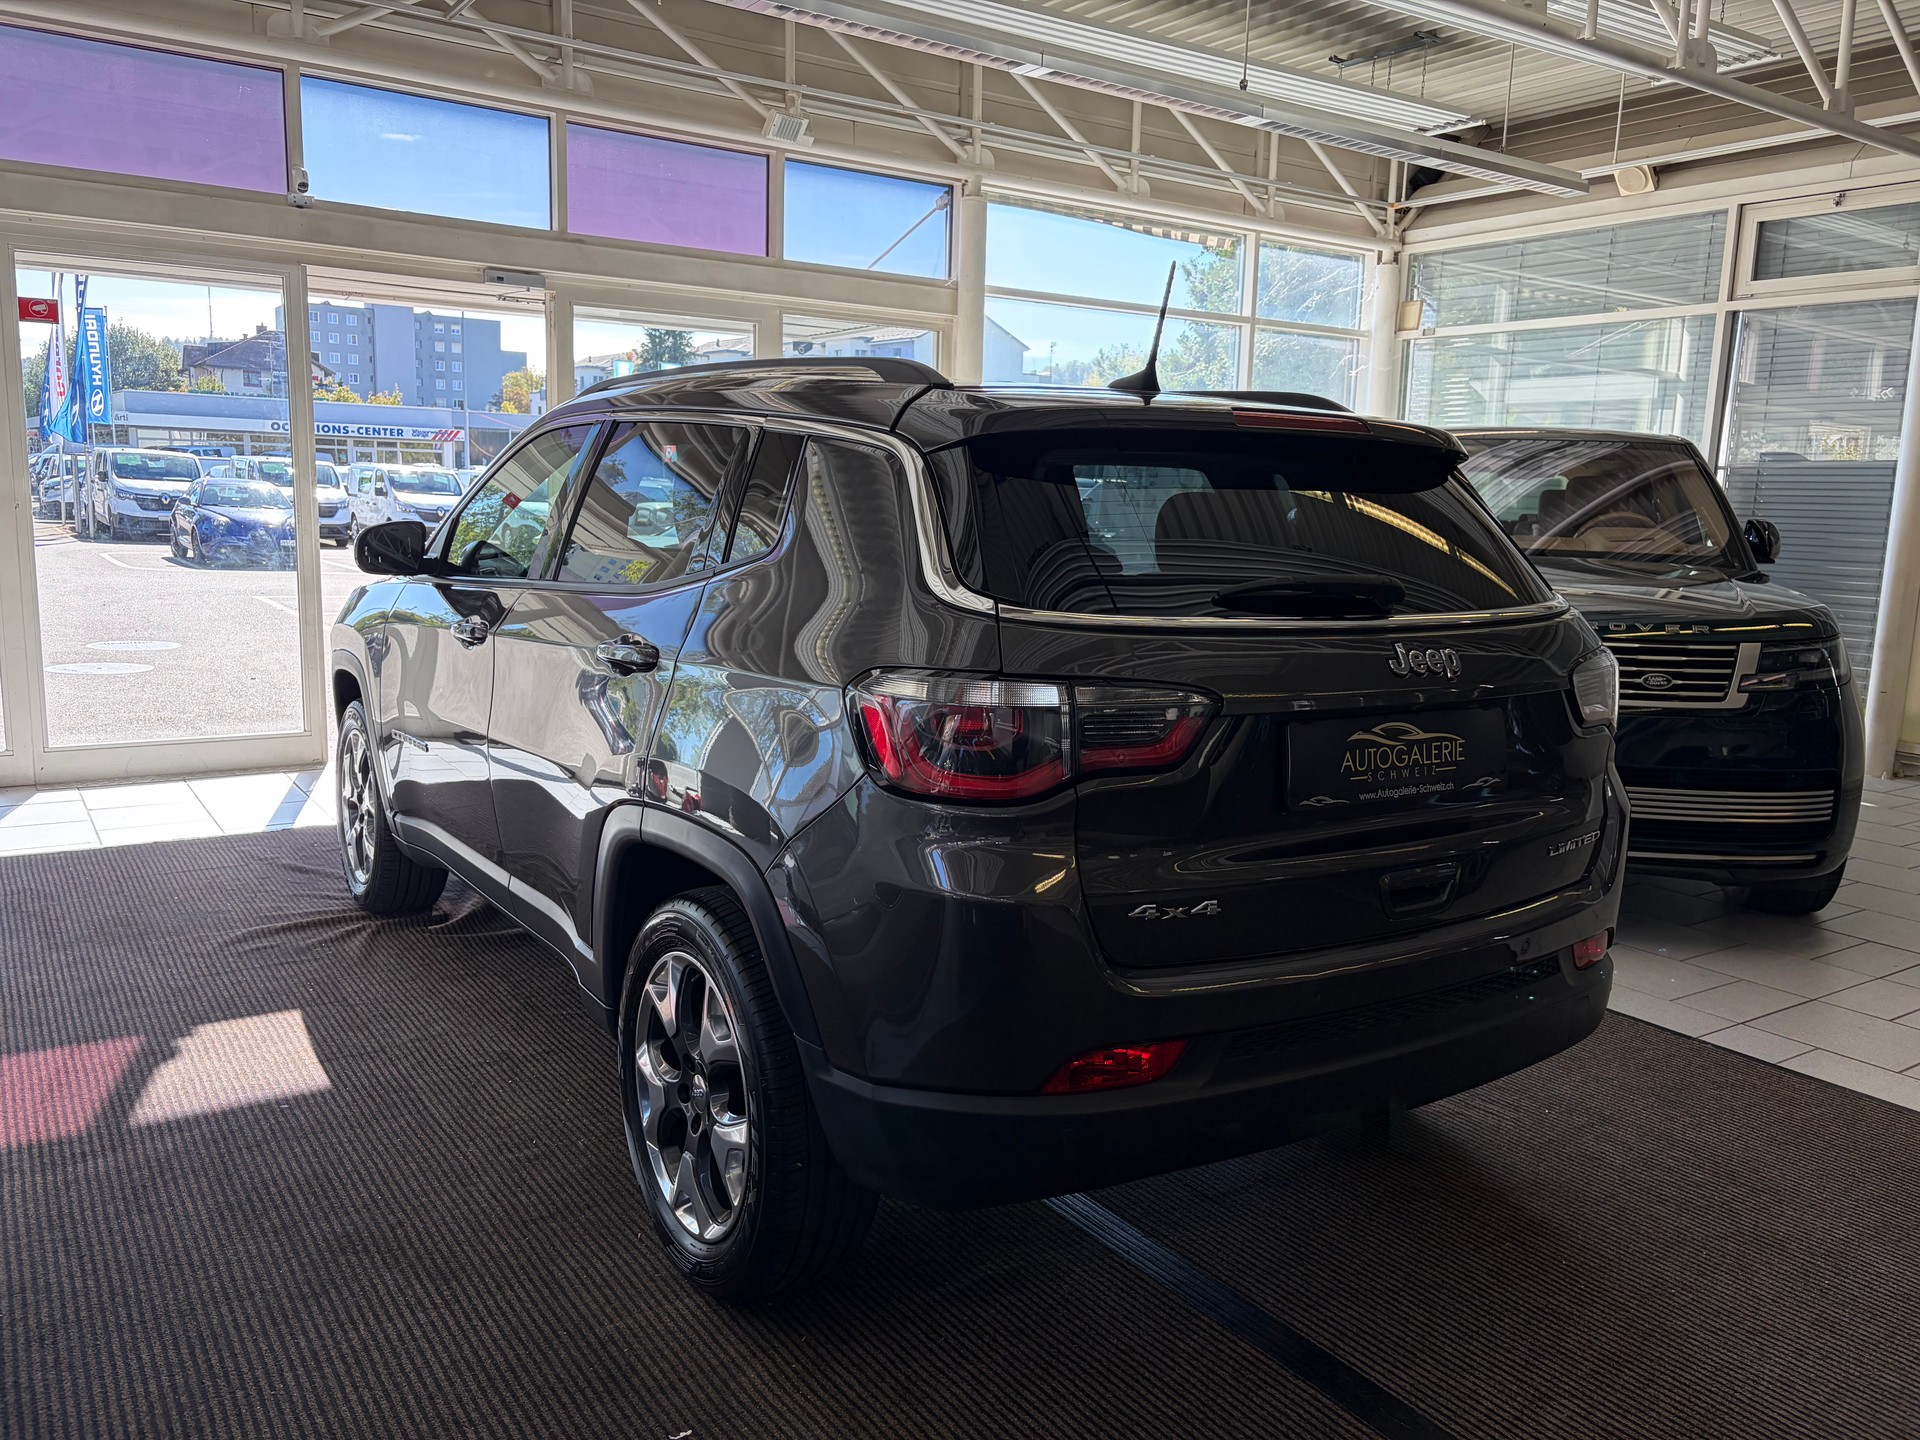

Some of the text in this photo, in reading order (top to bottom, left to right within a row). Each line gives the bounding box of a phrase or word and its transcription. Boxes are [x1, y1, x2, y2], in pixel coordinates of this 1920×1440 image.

[270, 421, 404, 437] OCIONS-CENTER
[1389, 643, 1462, 682] Jeep
[1341, 740, 1465, 773] AUTOGALERIE
[1367, 766, 1437, 782] SCHWEIZ
[1359, 782, 1455, 800] www.Autogalerie-Schweiz.ch
[1549, 830, 1600, 857] LIMITED
[1128, 900, 1222, 920] 4x4
